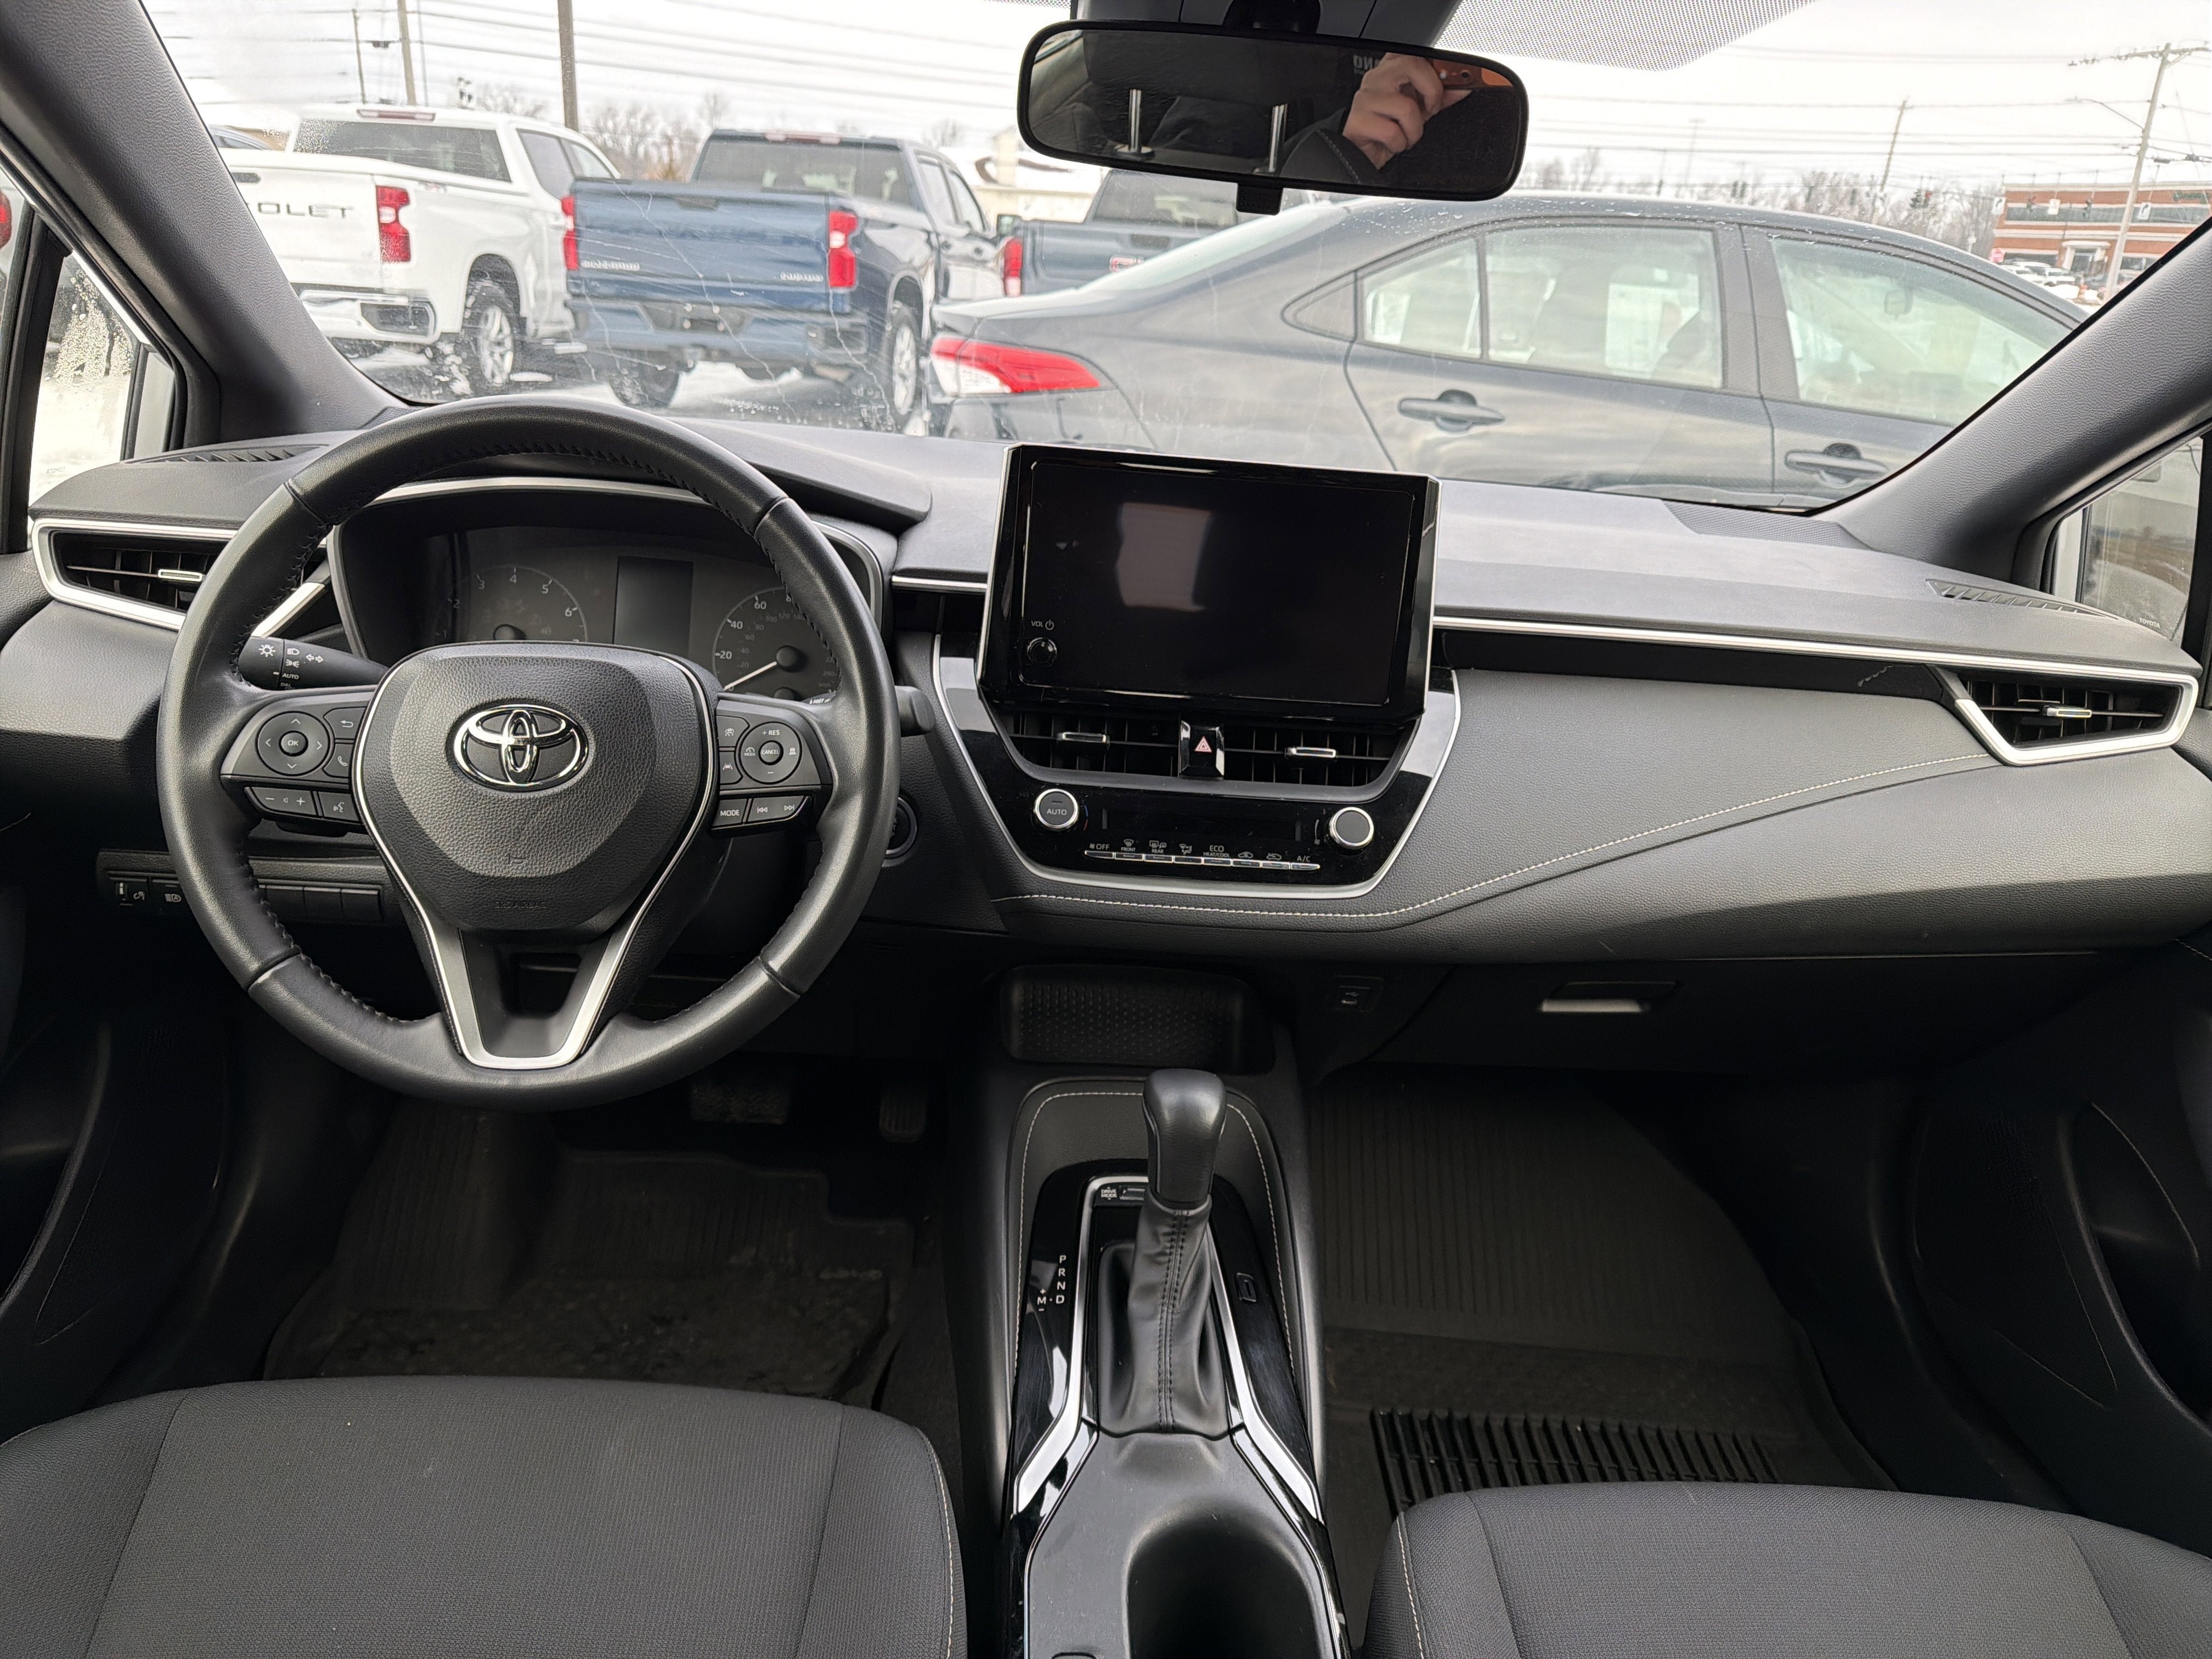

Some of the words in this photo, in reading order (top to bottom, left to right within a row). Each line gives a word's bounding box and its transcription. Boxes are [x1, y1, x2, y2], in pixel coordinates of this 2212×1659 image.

[510, 575, 517, 584] 4
[479, 580, 486, 590] 3
[542, 584, 549, 594] 5
[754, 601, 766, 610] 60
[565, 607, 572, 617] 6
[730, 620, 743, 629] 40
[2139, 617, 2160, 628] TOYOTA
[720, 651, 732, 659] 20
[1059, 1255, 1066, 1264] P
[1058, 1268, 1066, 1277] R
[1057, 1281, 1066, 1290] N
[1036, 1296, 1047, 1305] M
[1056, 1295, 1065, 1304] D
